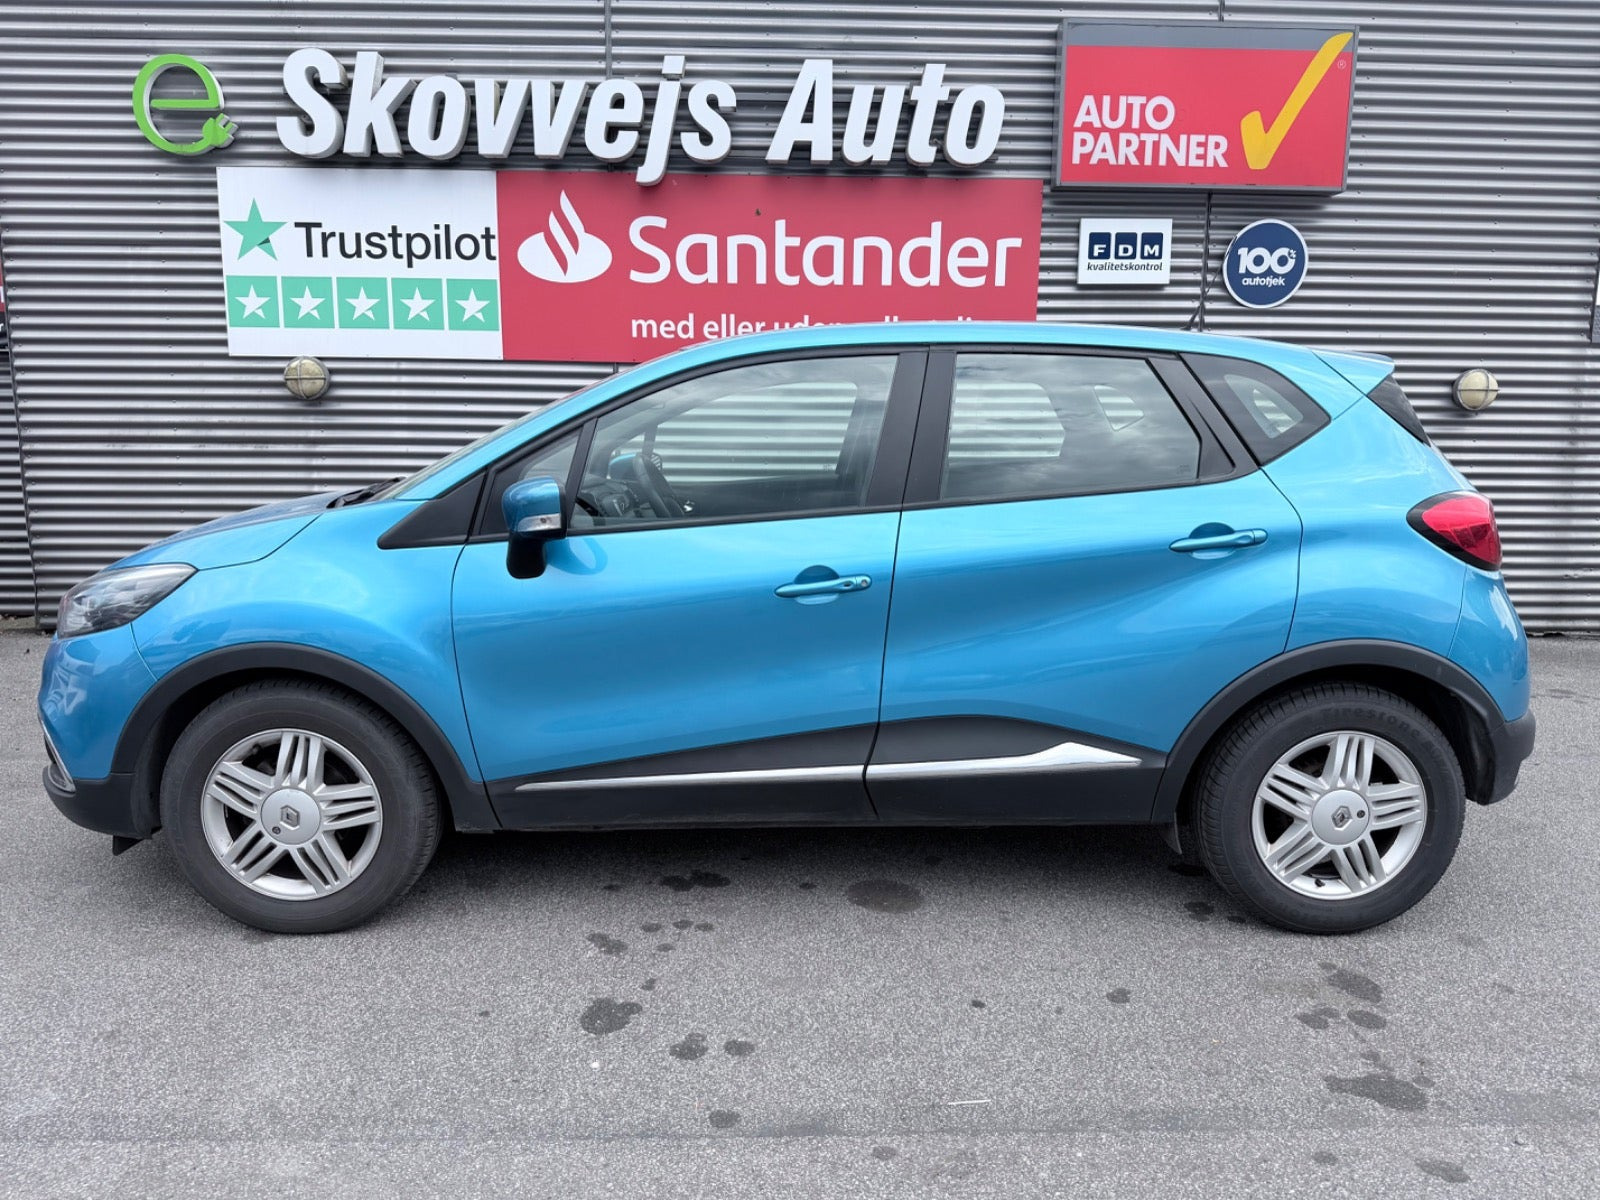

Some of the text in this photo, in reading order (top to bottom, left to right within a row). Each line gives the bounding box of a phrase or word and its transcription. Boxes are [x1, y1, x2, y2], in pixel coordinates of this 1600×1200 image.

[276, 47, 1006, 187] Skovvejs Auto
[1073, 94, 1176, 131] AUTO
[1071, 131, 1229, 168] PARTNER
[294, 221, 497, 268] Trustpilot
[628, 215, 1023, 288] Santander
[1092, 243, 1161, 258] FDM
[1087, 261, 1163, 271] kvalitetskontrol
[1241, 275, 1286, 288] autotjek
[631, 313, 695, 339] med
